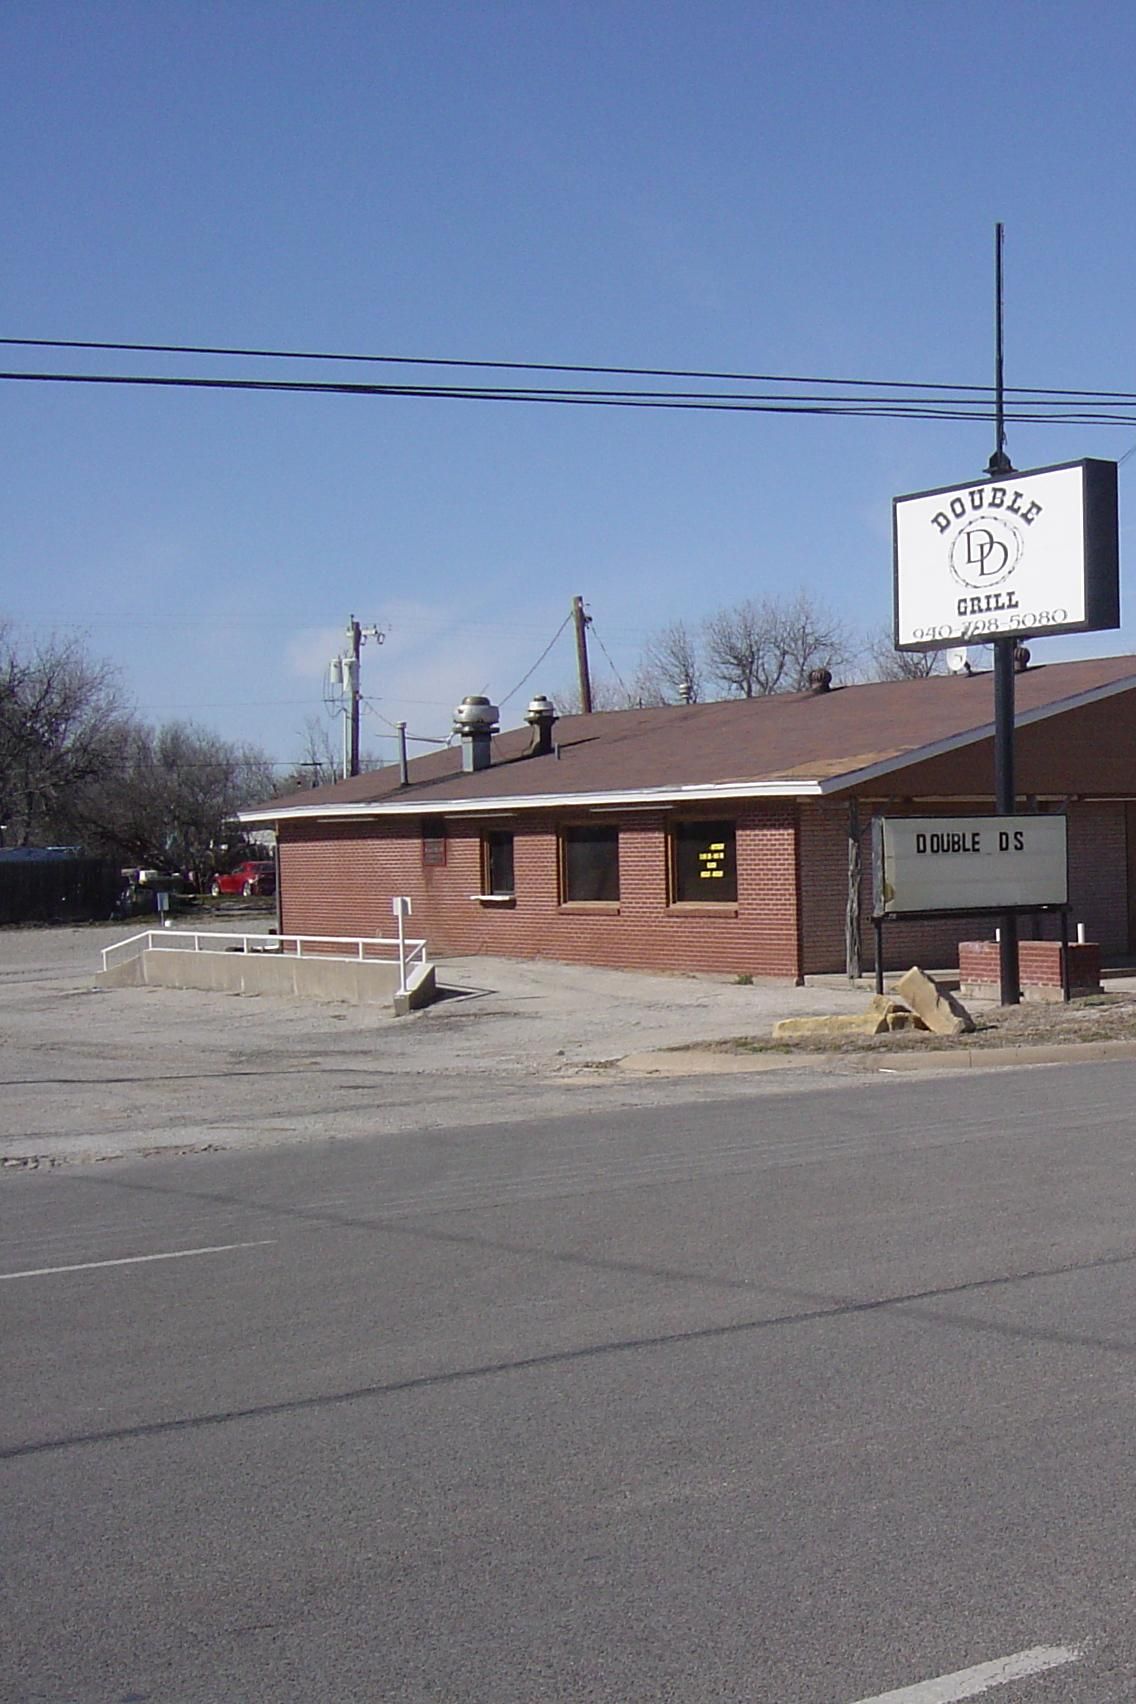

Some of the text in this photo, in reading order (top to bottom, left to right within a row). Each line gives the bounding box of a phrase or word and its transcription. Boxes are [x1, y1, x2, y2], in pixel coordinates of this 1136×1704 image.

[931, 487, 1043, 534] DOUBLE
[966, 528, 1009, 577] DD
[957, 591, 1019, 616] GRILL
[916, 832, 980, 853] DOUBLE
